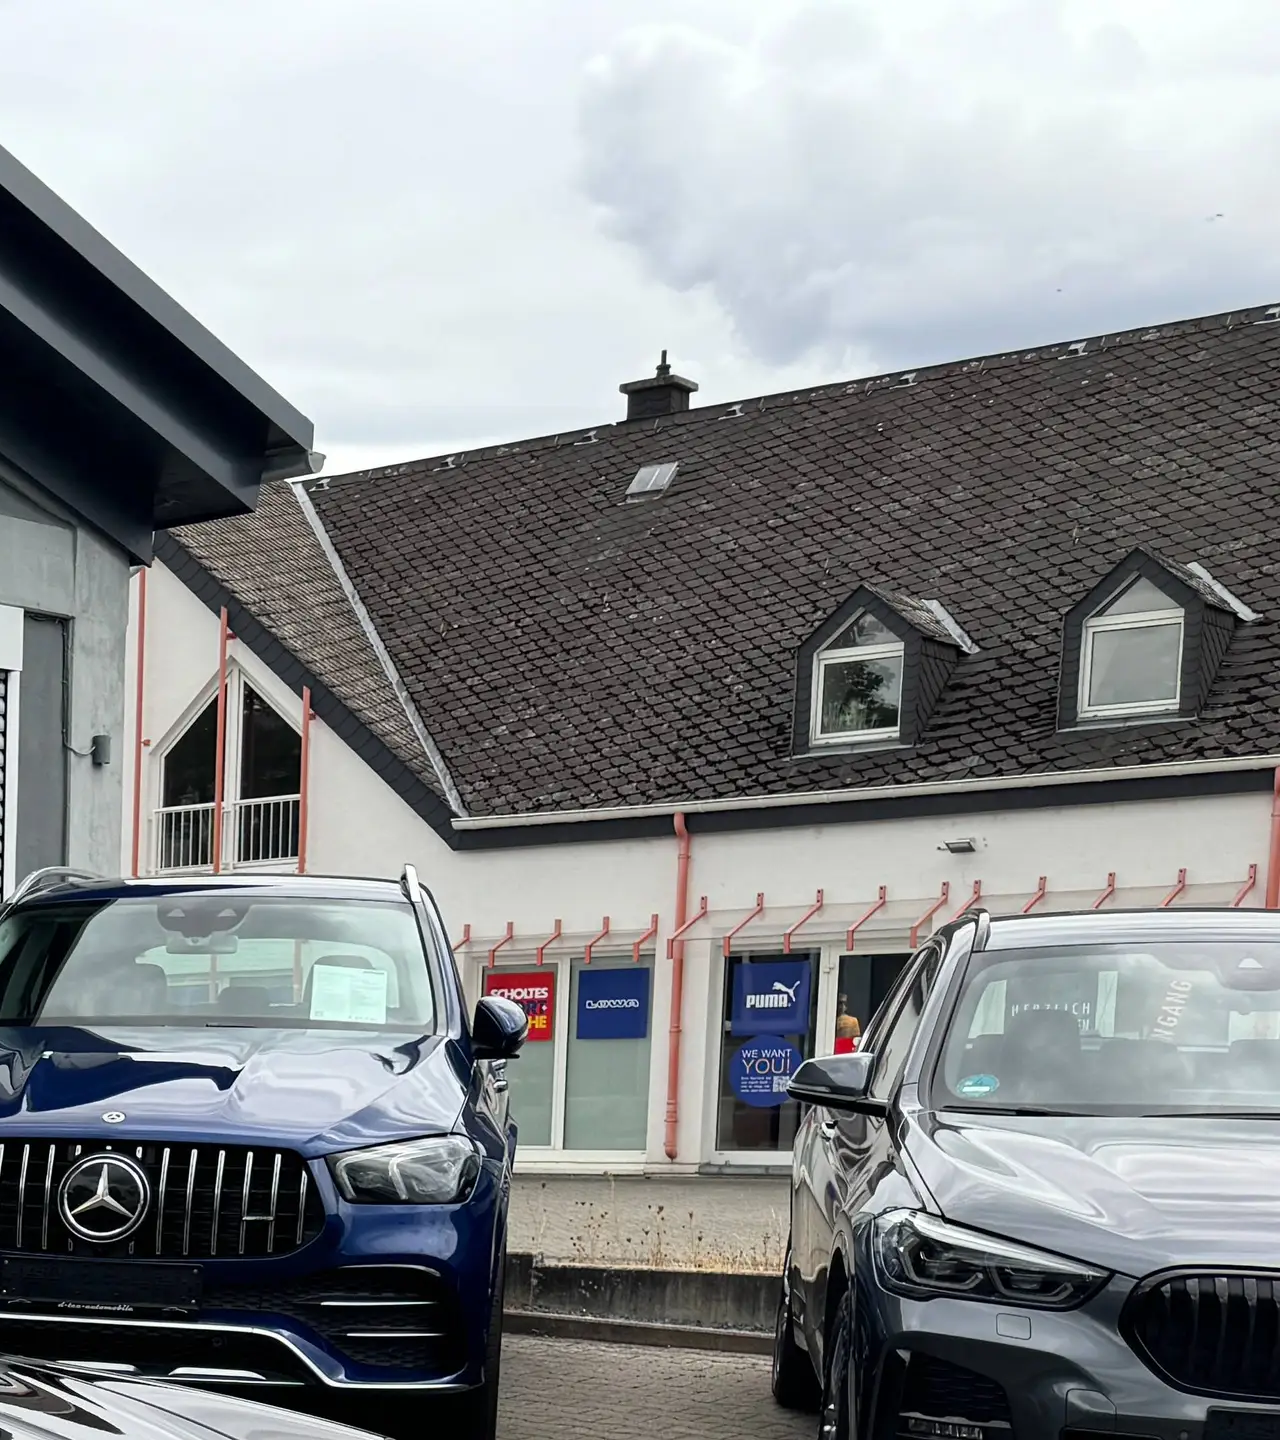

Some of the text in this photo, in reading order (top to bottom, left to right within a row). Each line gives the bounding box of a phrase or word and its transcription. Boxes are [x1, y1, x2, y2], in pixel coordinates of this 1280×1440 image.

[491, 987, 549, 999] SCHOLTES
[586, 999, 639, 1009] LOWA
[746, 994, 788, 1008] PUMA
[1150, 980, 1192, 1041] NGANG
[742, 1049, 793, 1058] WE WANT
[742, 1059, 790, 1075] YOU!
